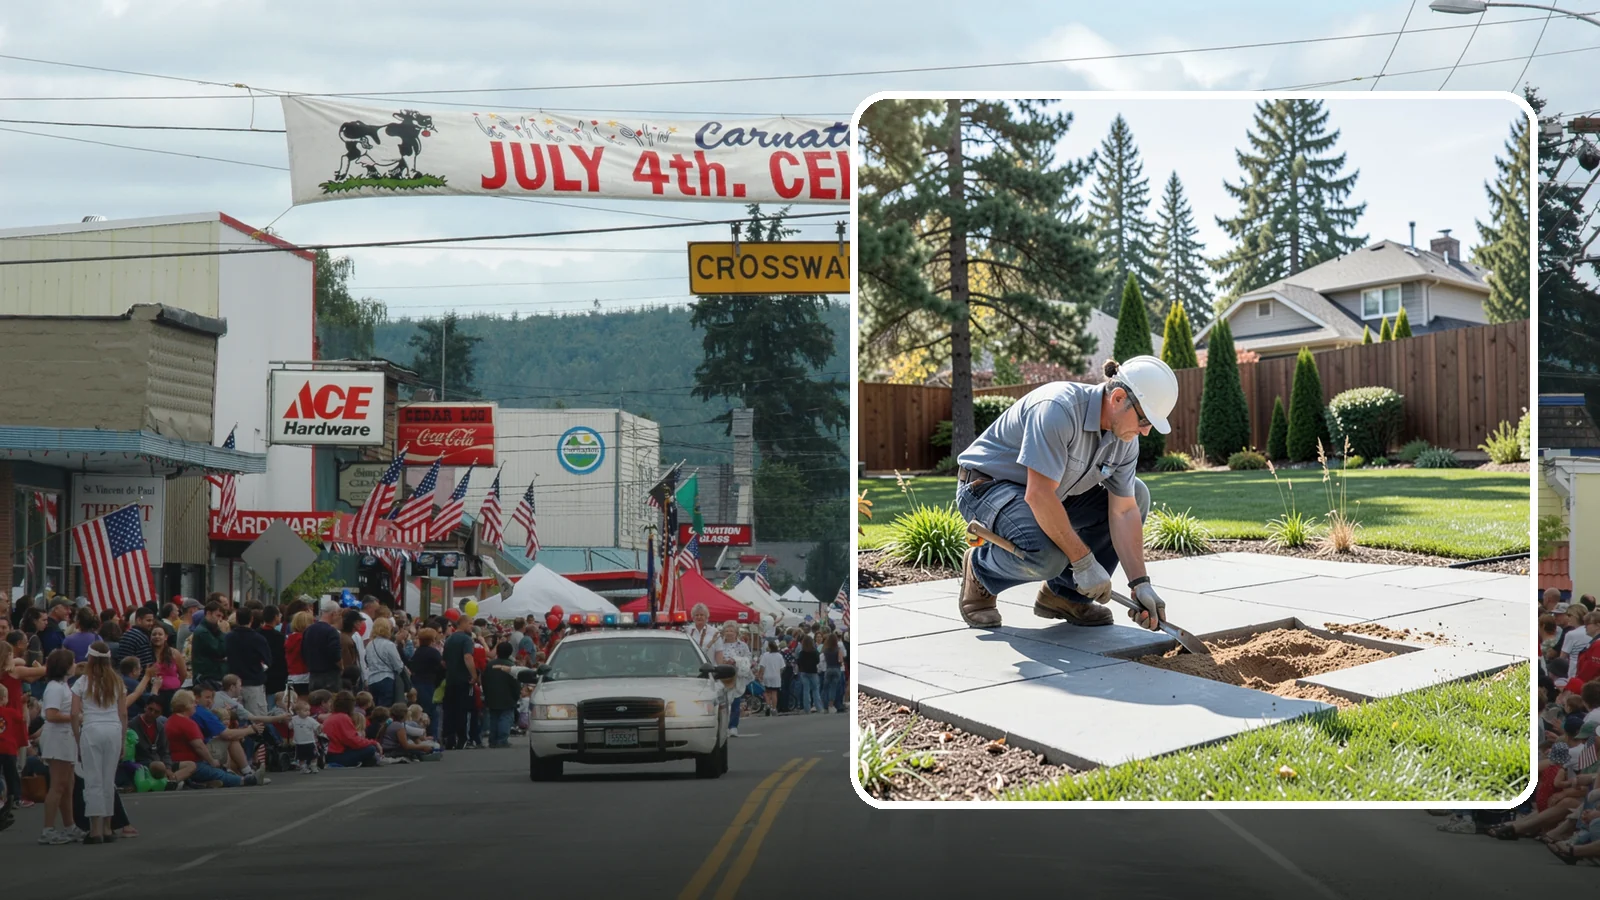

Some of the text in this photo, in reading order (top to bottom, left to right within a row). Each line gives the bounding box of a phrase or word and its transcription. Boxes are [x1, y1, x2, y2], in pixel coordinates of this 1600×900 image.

[695, 121, 850, 150] Carnat
[481, 140, 605, 193] JULY
[632, 150, 746, 198] 4th.
[697, 254, 850, 280] CROSSWA
[283, 380, 373, 420] ACE
[406, 409, 484, 421] CEDAR LOG
[283, 421, 371, 436] Hardware
[416, 428, 477, 447] Coca-Cola
[95, 485, 124, 494] Vincent
[126, 486, 135, 494] de
[137, 486, 155, 495] Paul
[688, 526, 741, 535] CRNATION
[699, 535, 730, 543] GLASS
